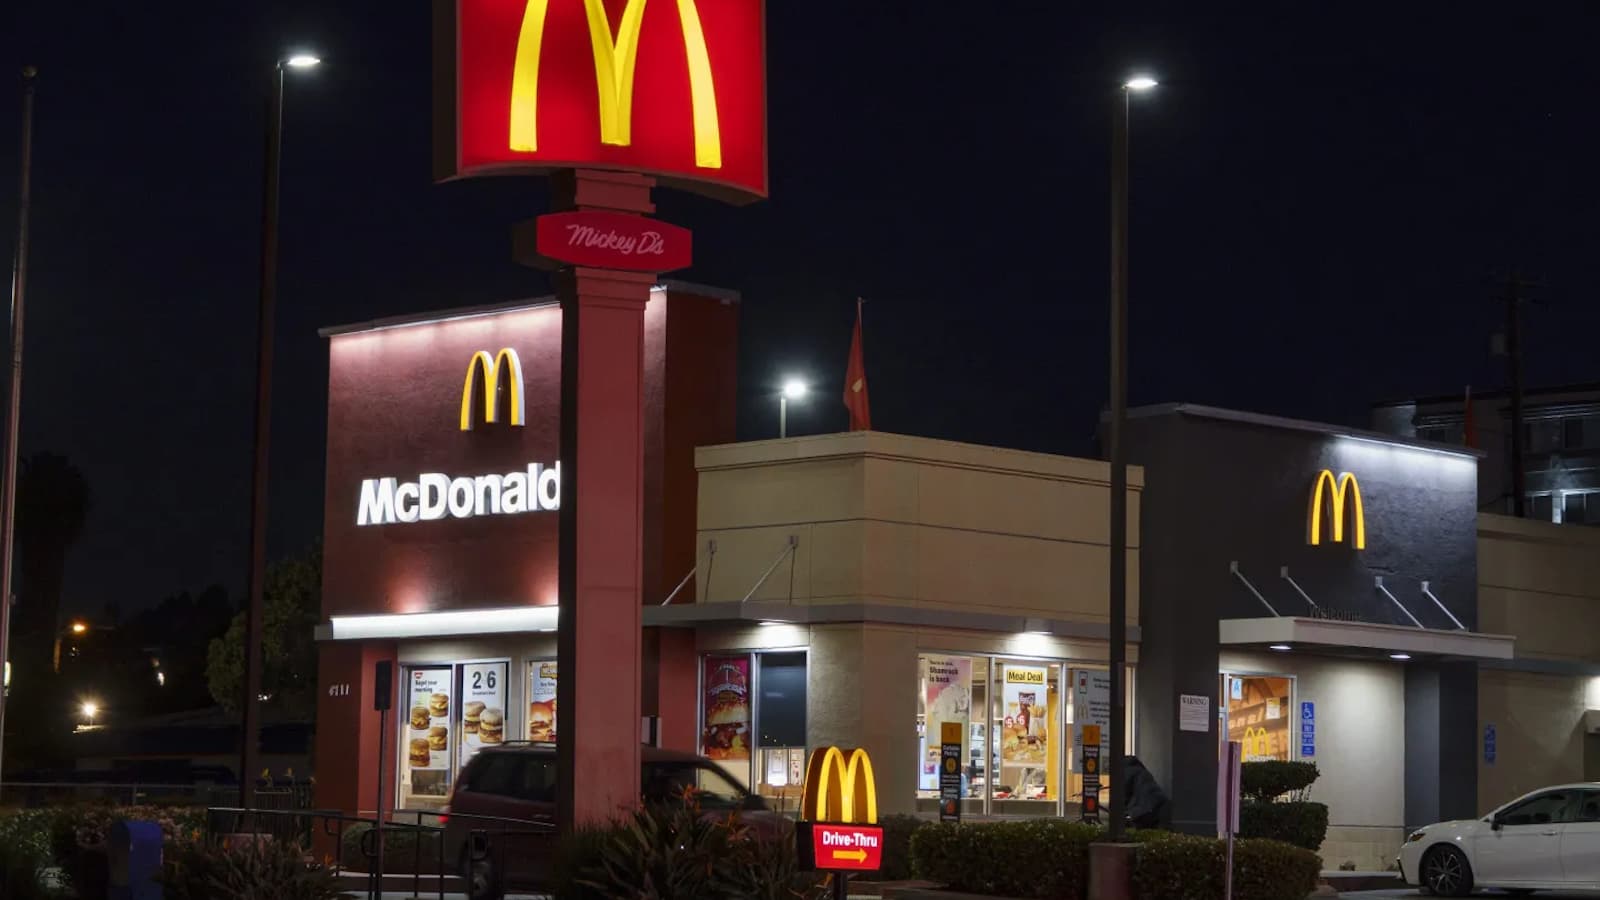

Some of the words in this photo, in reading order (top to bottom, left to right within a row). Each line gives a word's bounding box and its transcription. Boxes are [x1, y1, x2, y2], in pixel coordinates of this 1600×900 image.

[566, 224, 636, 255] Mickey
[356, 460, 561, 526] McDonald
[472, 671, 482, 689] 2
[487, 670, 497, 689] 6
[1008, 671, 1026, 681] Meal
[1027, 671, 1043, 682] Deal
[822, 830, 878, 848] Drive-Thru
